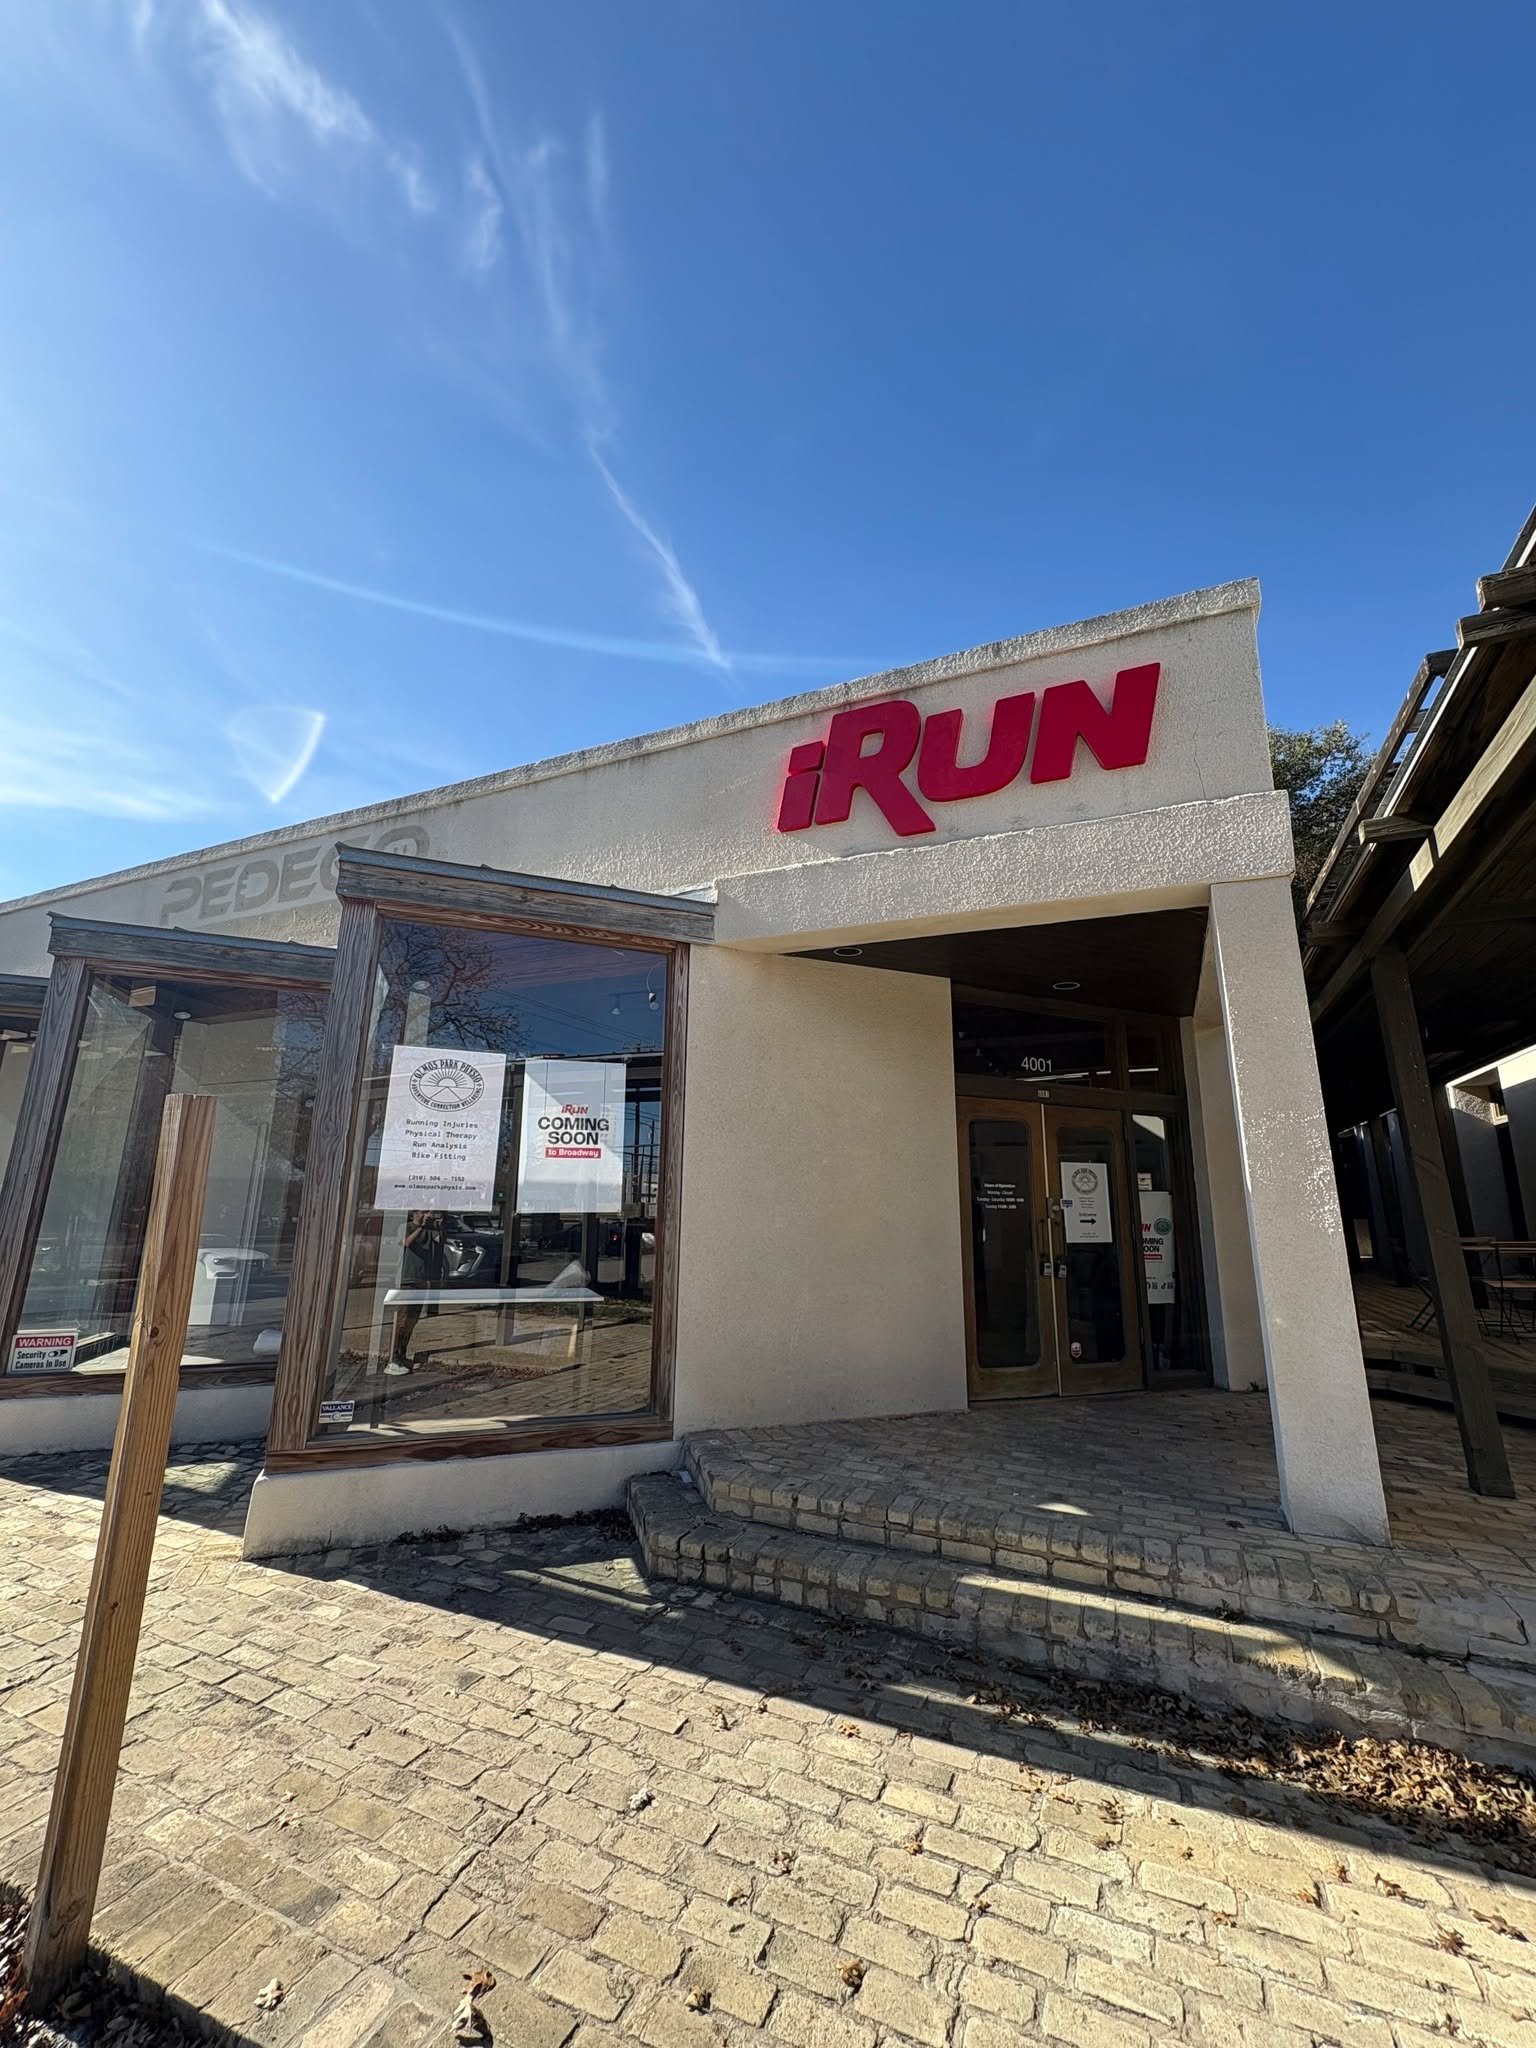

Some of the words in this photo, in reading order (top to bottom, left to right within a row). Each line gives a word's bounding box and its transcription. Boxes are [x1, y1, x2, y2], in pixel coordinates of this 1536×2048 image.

[777, 662, 1160, 836] iRUN
[1020, 1056, 1052, 1073] 4001
[414, 1060, 438, 1080] OLMOS
[440, 1059, 458, 1070] PARK
[460, 1062, 483, 1083] PHYSIO
[406, 1119, 439, 1128] Running
[443, 1120, 478, 1129] Injuries
[537, 1116, 610, 1132] COMING
[404, 1129, 441, 1138] Physical
[445, 1131, 478, 1141] Therapy
[547, 1131, 600, 1146] SOON
[431, 1142, 467, 1151] Analysis
[434, 1153, 466, 1162] Fitting
[558, 1149, 600, 1158] Broadway
[19, 1337, 72, 1347] WARNING
[17, 1350, 46, 1360] Security
[15, 1360, 44, 1370] Cameras
[46, 1359, 53, 1368] In
[54, 1359, 67, 1368] Use
